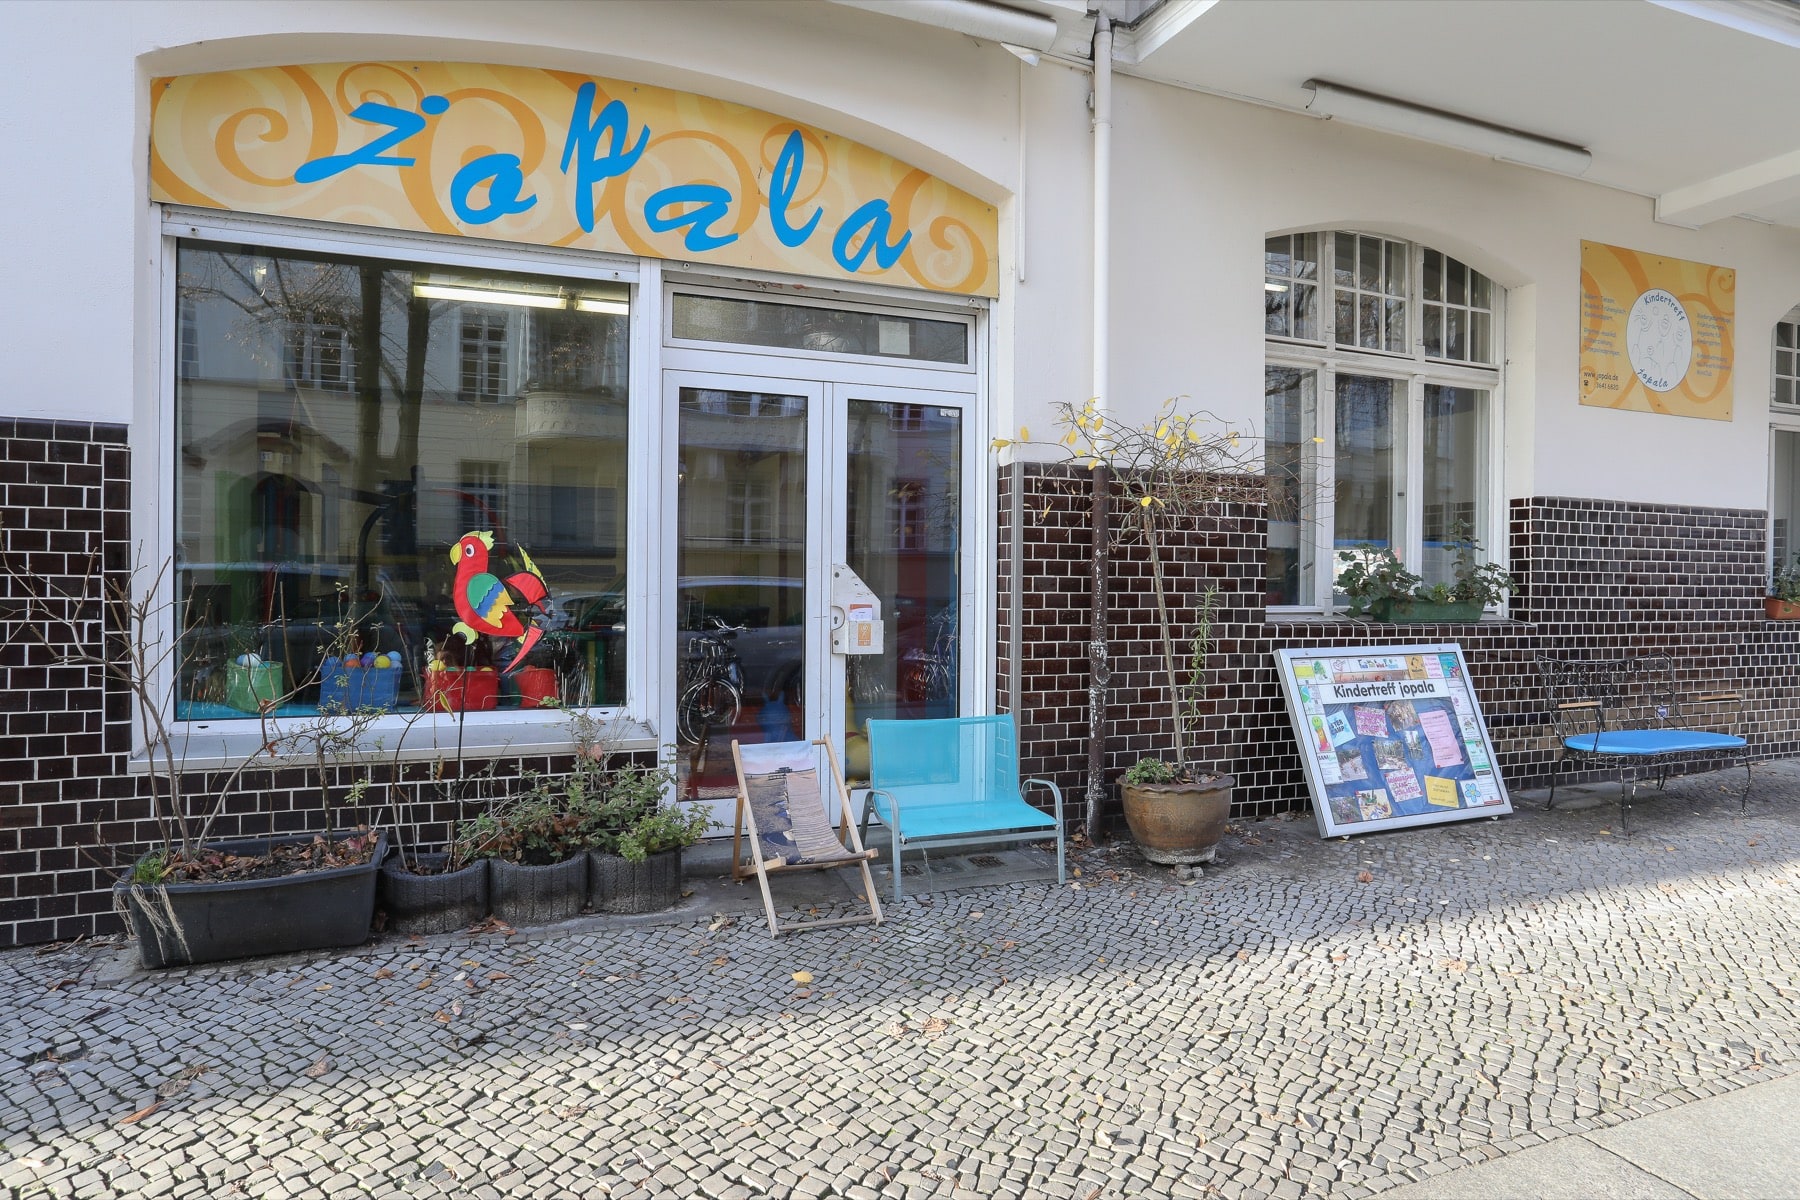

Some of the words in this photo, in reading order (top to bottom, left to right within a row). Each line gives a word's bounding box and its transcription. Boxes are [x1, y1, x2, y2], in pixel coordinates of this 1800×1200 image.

[1644, 292, 1686, 321] Kindertreff
[1333, 683, 1397, 699] Kindertreff
[1399, 681, 1436, 698] jopala
